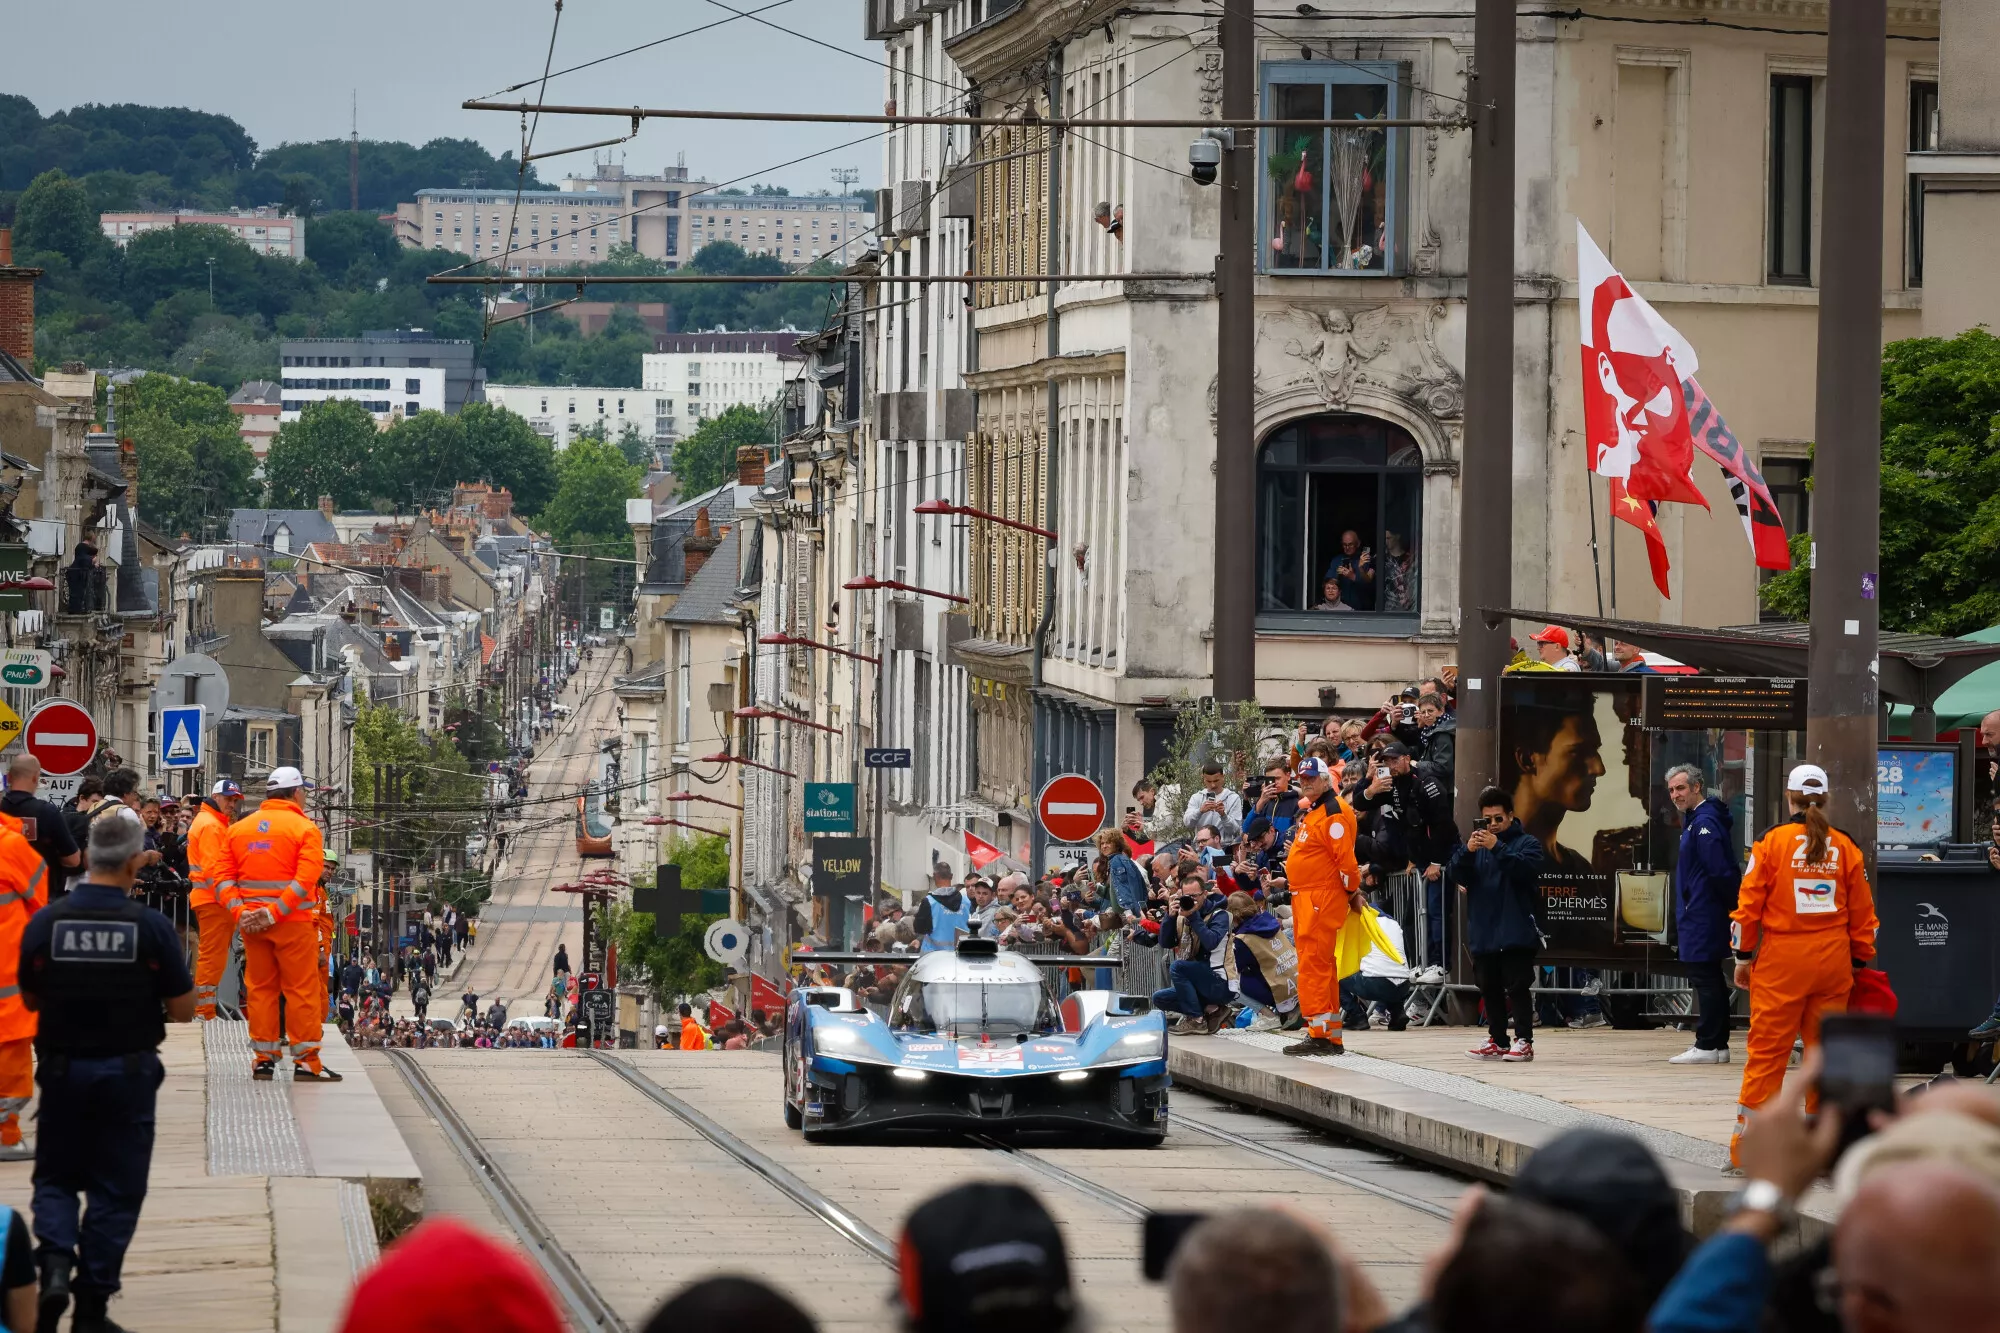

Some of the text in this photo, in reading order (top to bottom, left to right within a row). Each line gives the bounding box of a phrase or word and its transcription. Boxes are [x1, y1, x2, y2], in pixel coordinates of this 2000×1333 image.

[0, 571, 24, 582] IVE
[5, 650, 41, 664] happy
[6, 671, 25, 679] PMU
[870, 753, 906, 763] CCF
[1877, 767, 1904, 782] 28
[50, 780, 74, 790] AUF
[1792, 834, 1840, 862] 2h
[822, 859, 861, 873] YELLOW
[1791, 860, 1805, 868] LE
[1539, 886, 1578, 897] TERRE
[1547, 896, 1608, 909] D'HERMÈS
